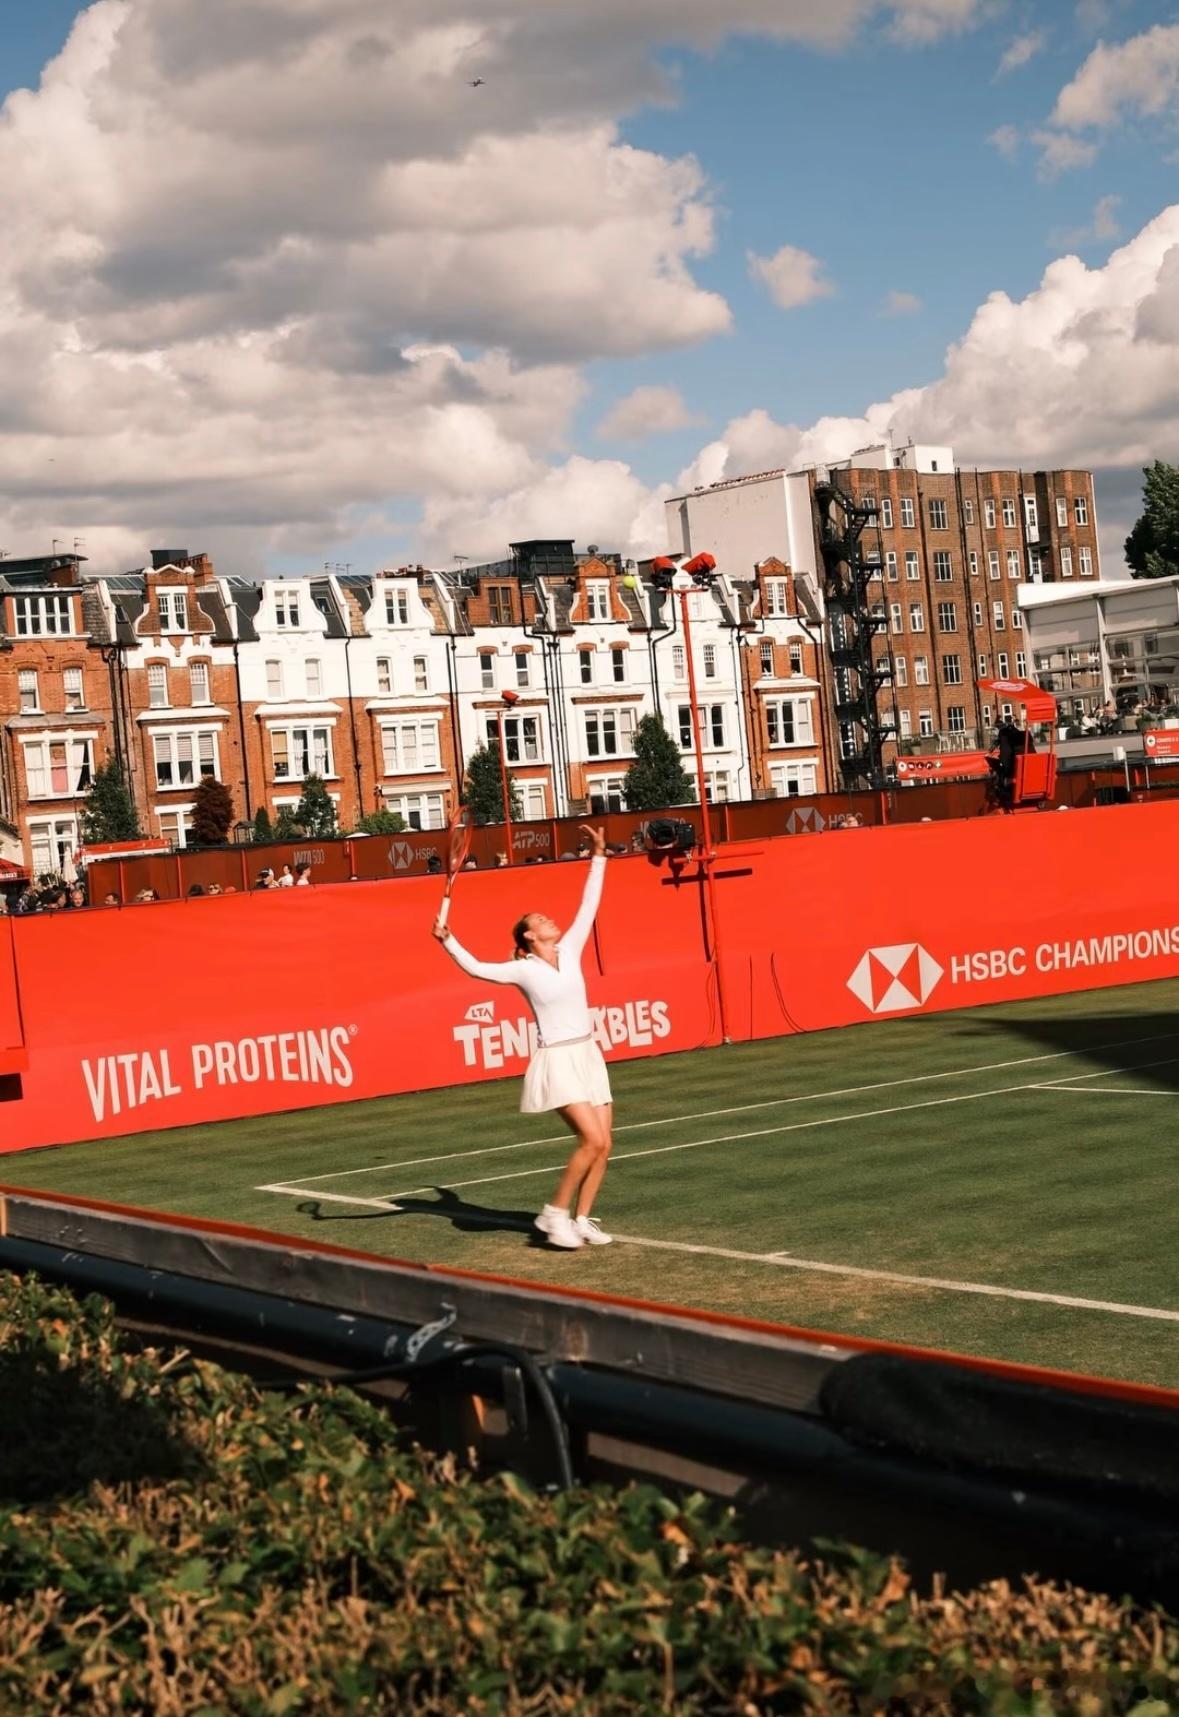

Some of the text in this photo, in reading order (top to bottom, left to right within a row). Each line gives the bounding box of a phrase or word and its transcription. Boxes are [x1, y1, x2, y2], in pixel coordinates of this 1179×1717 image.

[513, 830, 550, 849] ATP 500
[312, 848, 325, 865] 500
[950, 947, 1027, 984] HSBC
[471, 1007, 494, 1019] LTA
[81, 1048, 182, 1123] VITAL
